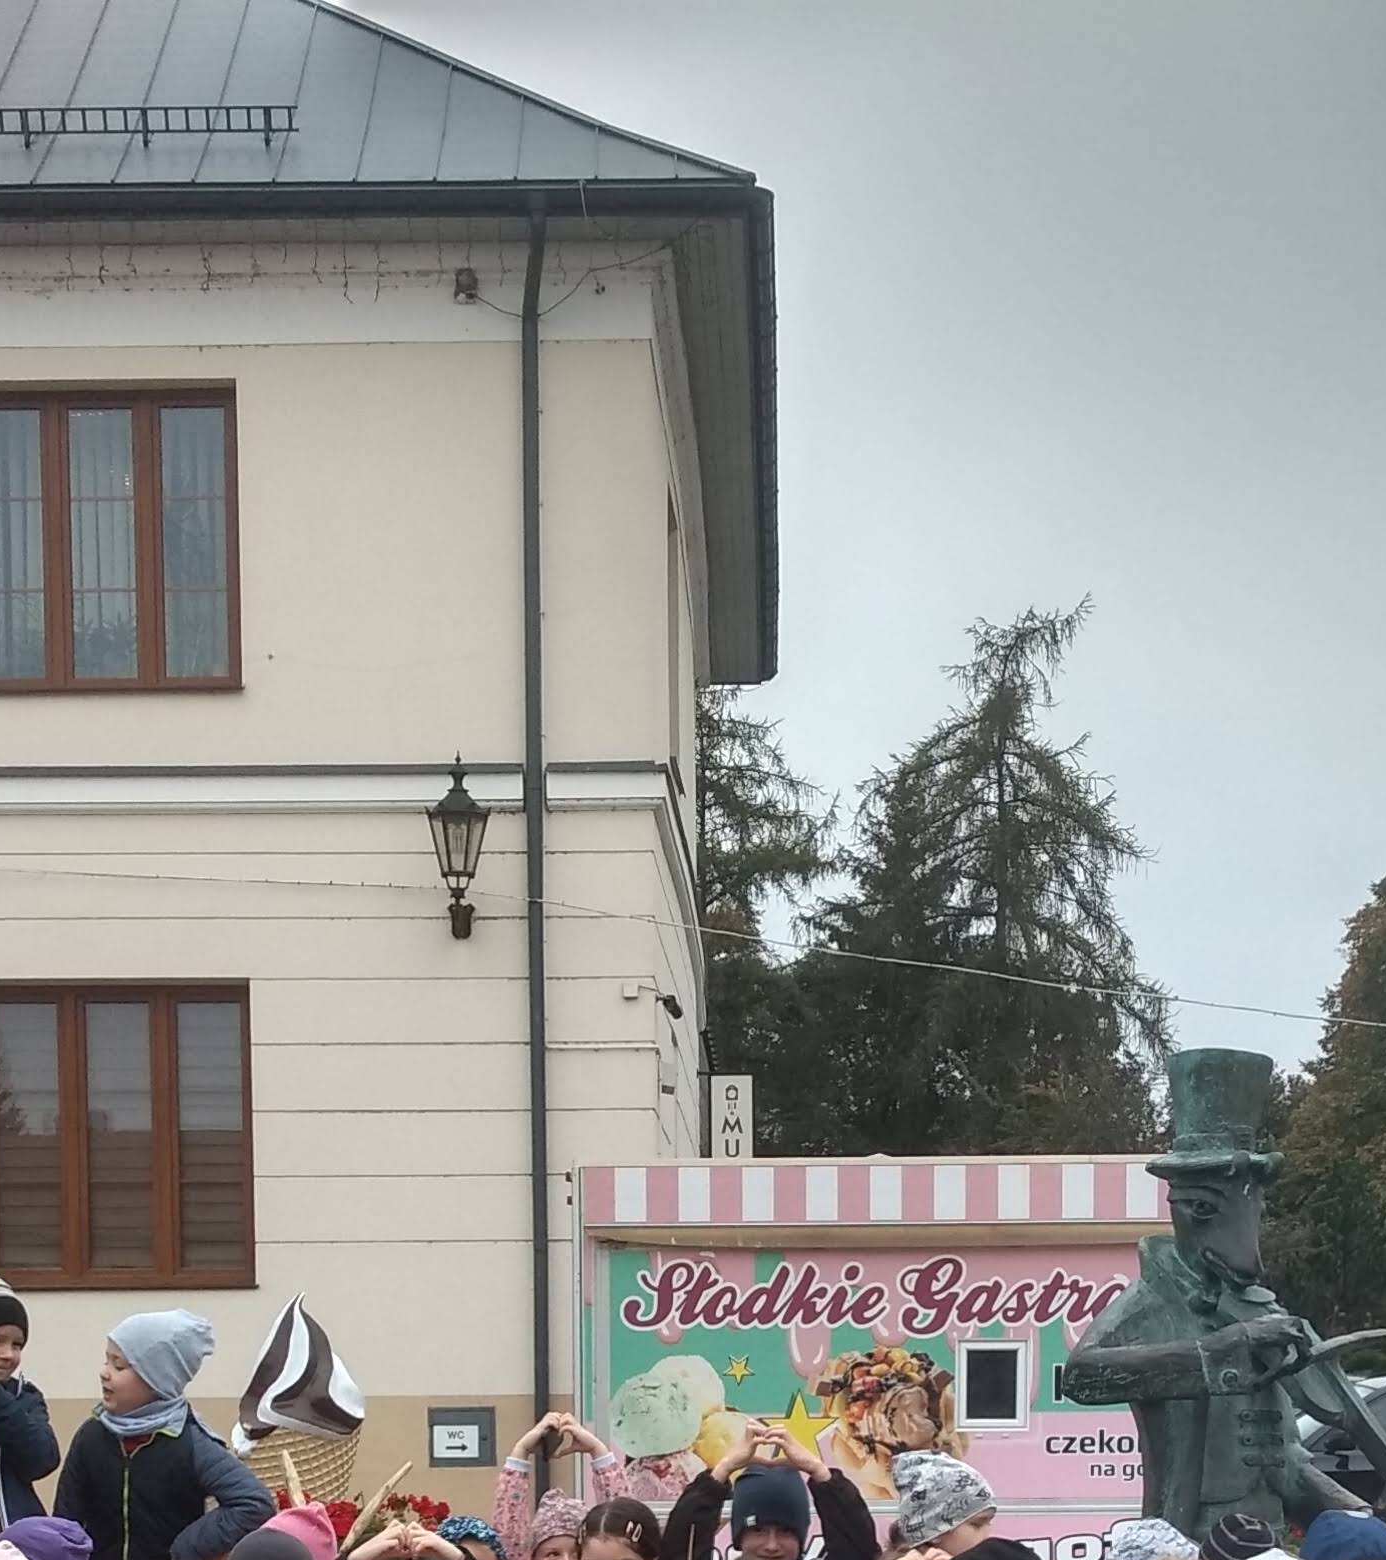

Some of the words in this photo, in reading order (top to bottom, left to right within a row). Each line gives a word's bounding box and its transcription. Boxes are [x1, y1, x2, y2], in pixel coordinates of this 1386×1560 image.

[621, 1260, 890, 1328] Słodkie
[447, 1430, 465, 1440] WC
[1090, 1464, 1116, 1477] na
